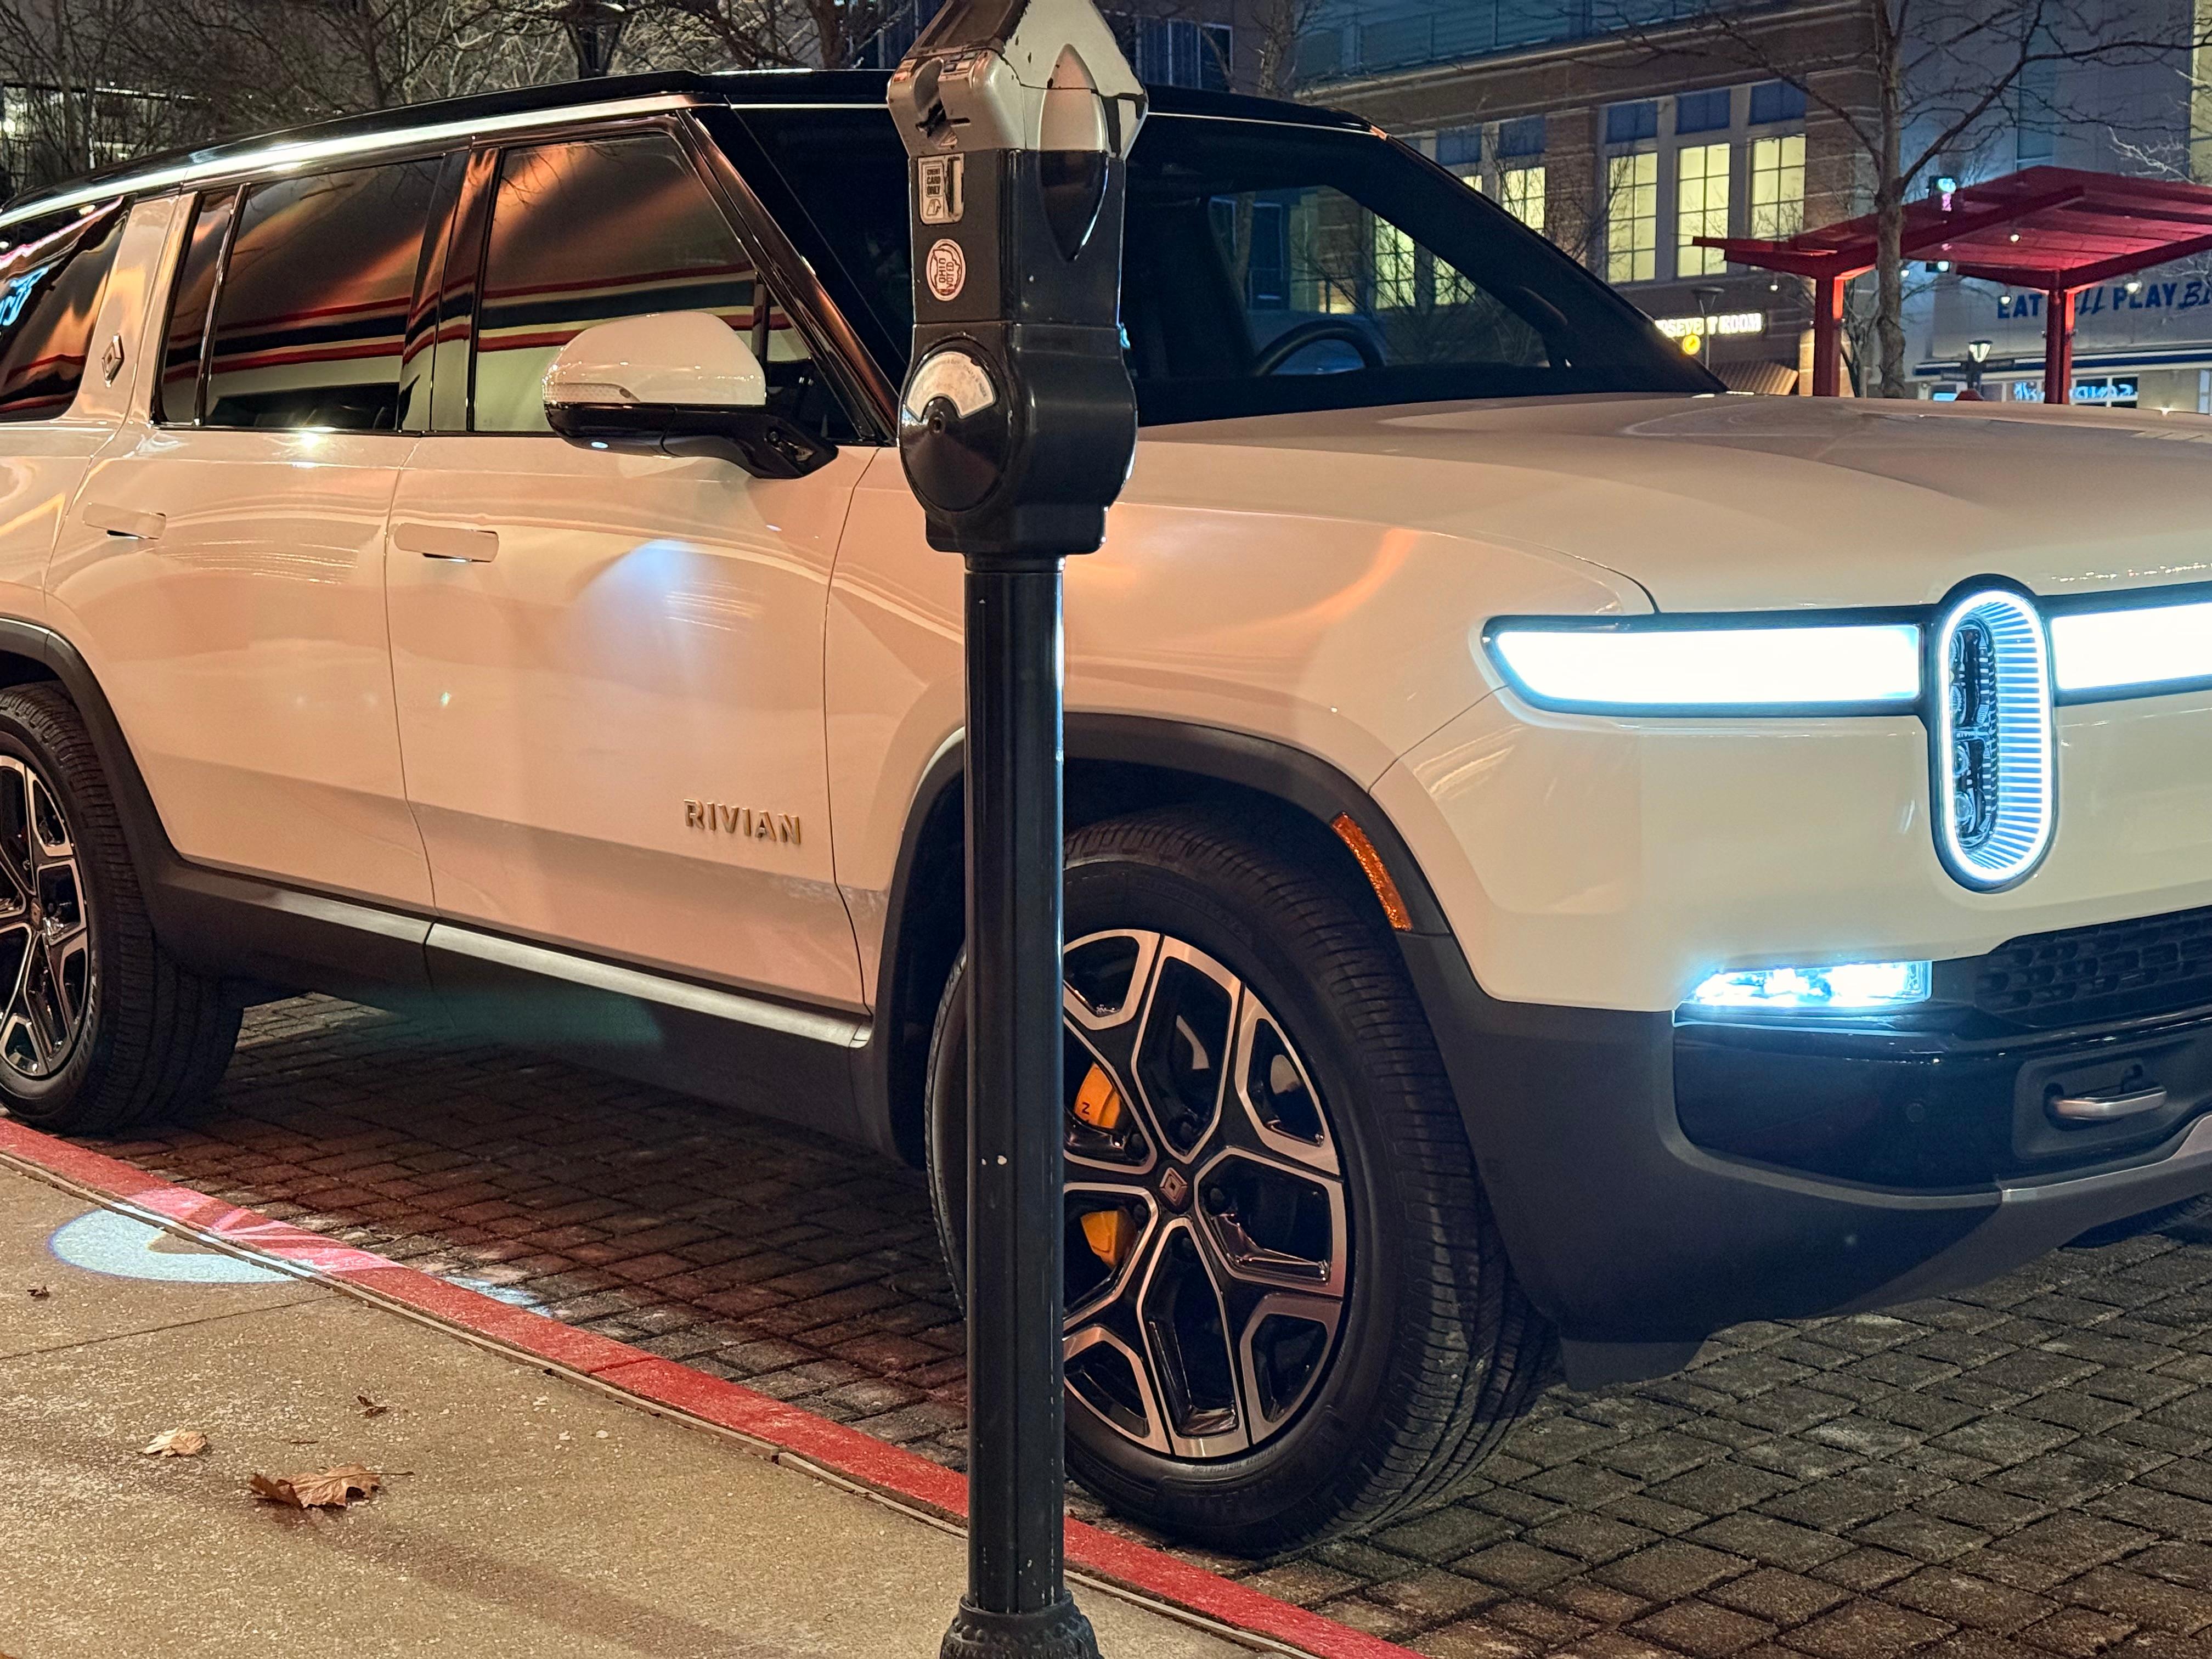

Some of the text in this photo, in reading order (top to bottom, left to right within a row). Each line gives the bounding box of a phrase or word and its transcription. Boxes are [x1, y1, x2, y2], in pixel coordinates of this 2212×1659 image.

[946, 262, 954, 289] VOTED
[1997, 293, 2042, 319] EAT
[2113, 282, 2177, 311] PLAY
[1719, 313, 1762, 334] ROOM
[684, 799, 801, 845] RIVIAN
